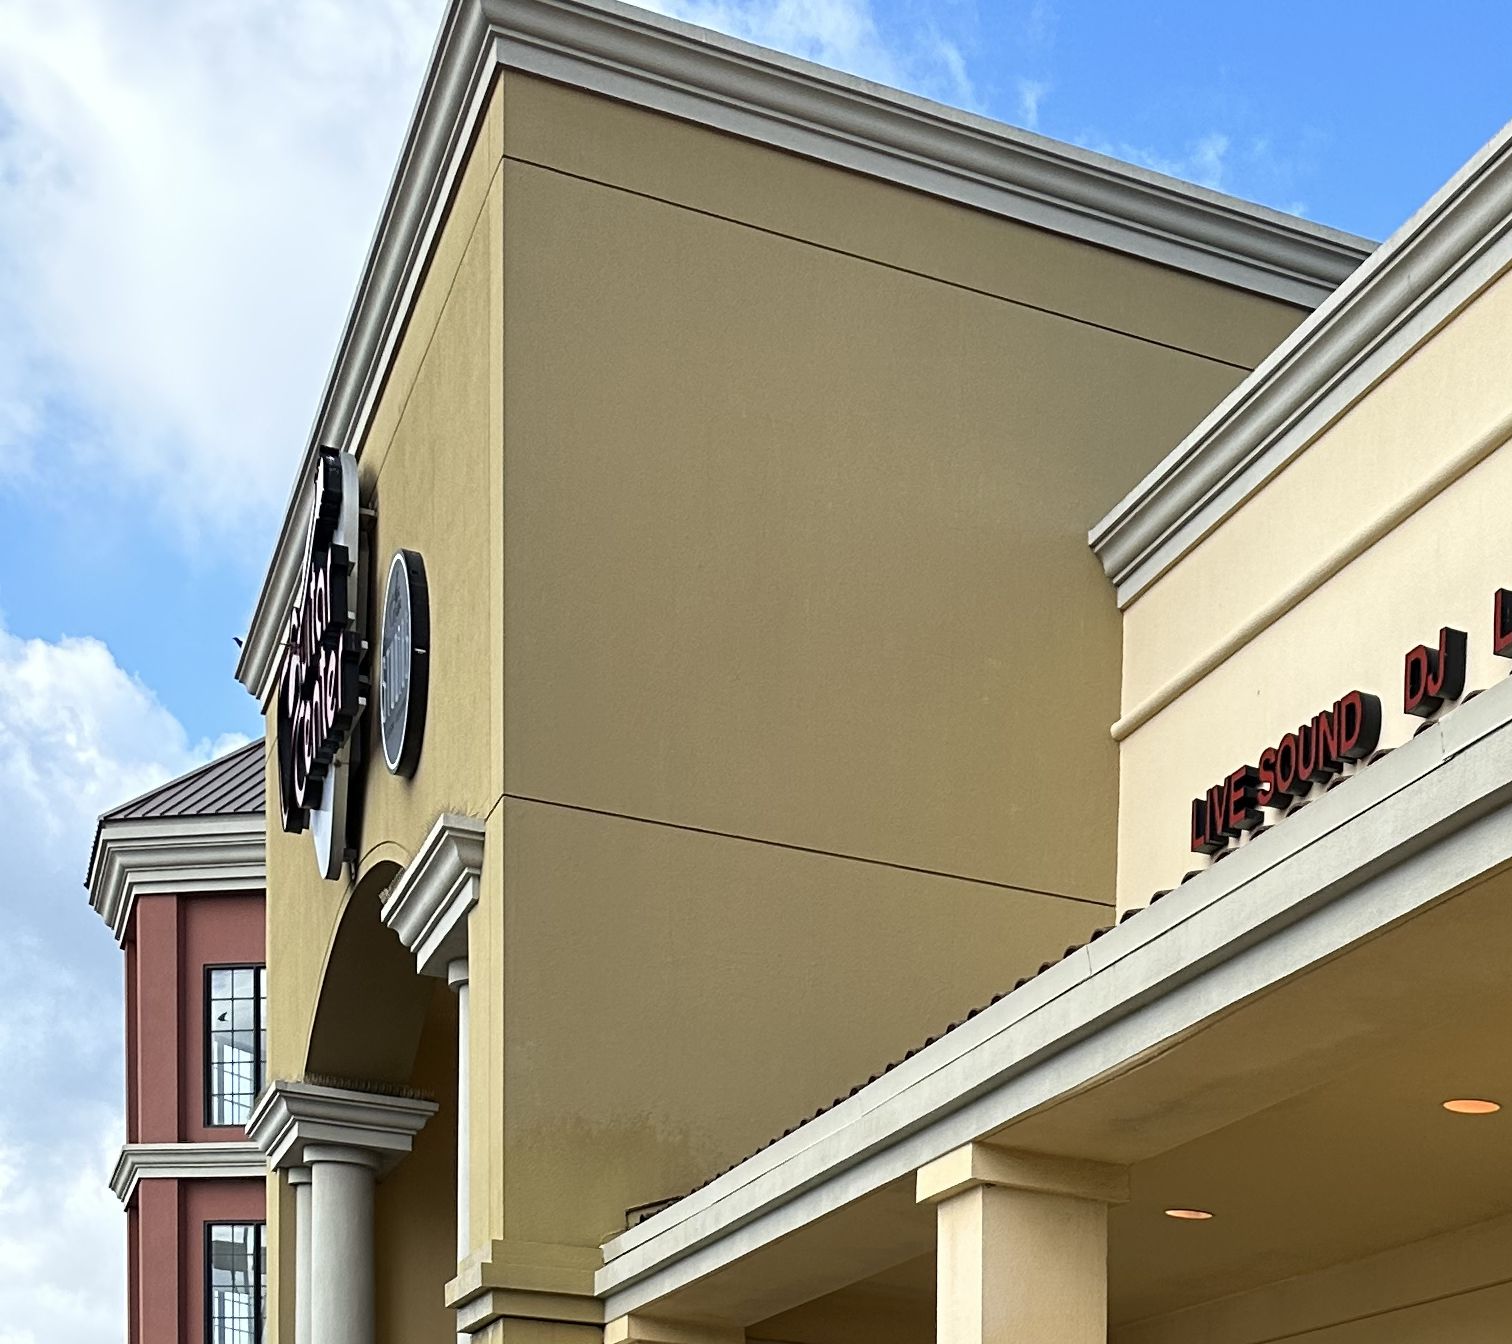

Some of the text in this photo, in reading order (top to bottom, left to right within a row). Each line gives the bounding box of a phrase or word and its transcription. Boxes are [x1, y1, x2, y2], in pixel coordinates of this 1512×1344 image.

[294, 631, 345, 809] Center
[1404, 627, 1458, 716] DJ
[1191, 690, 1373, 853] LIVE SOUND
